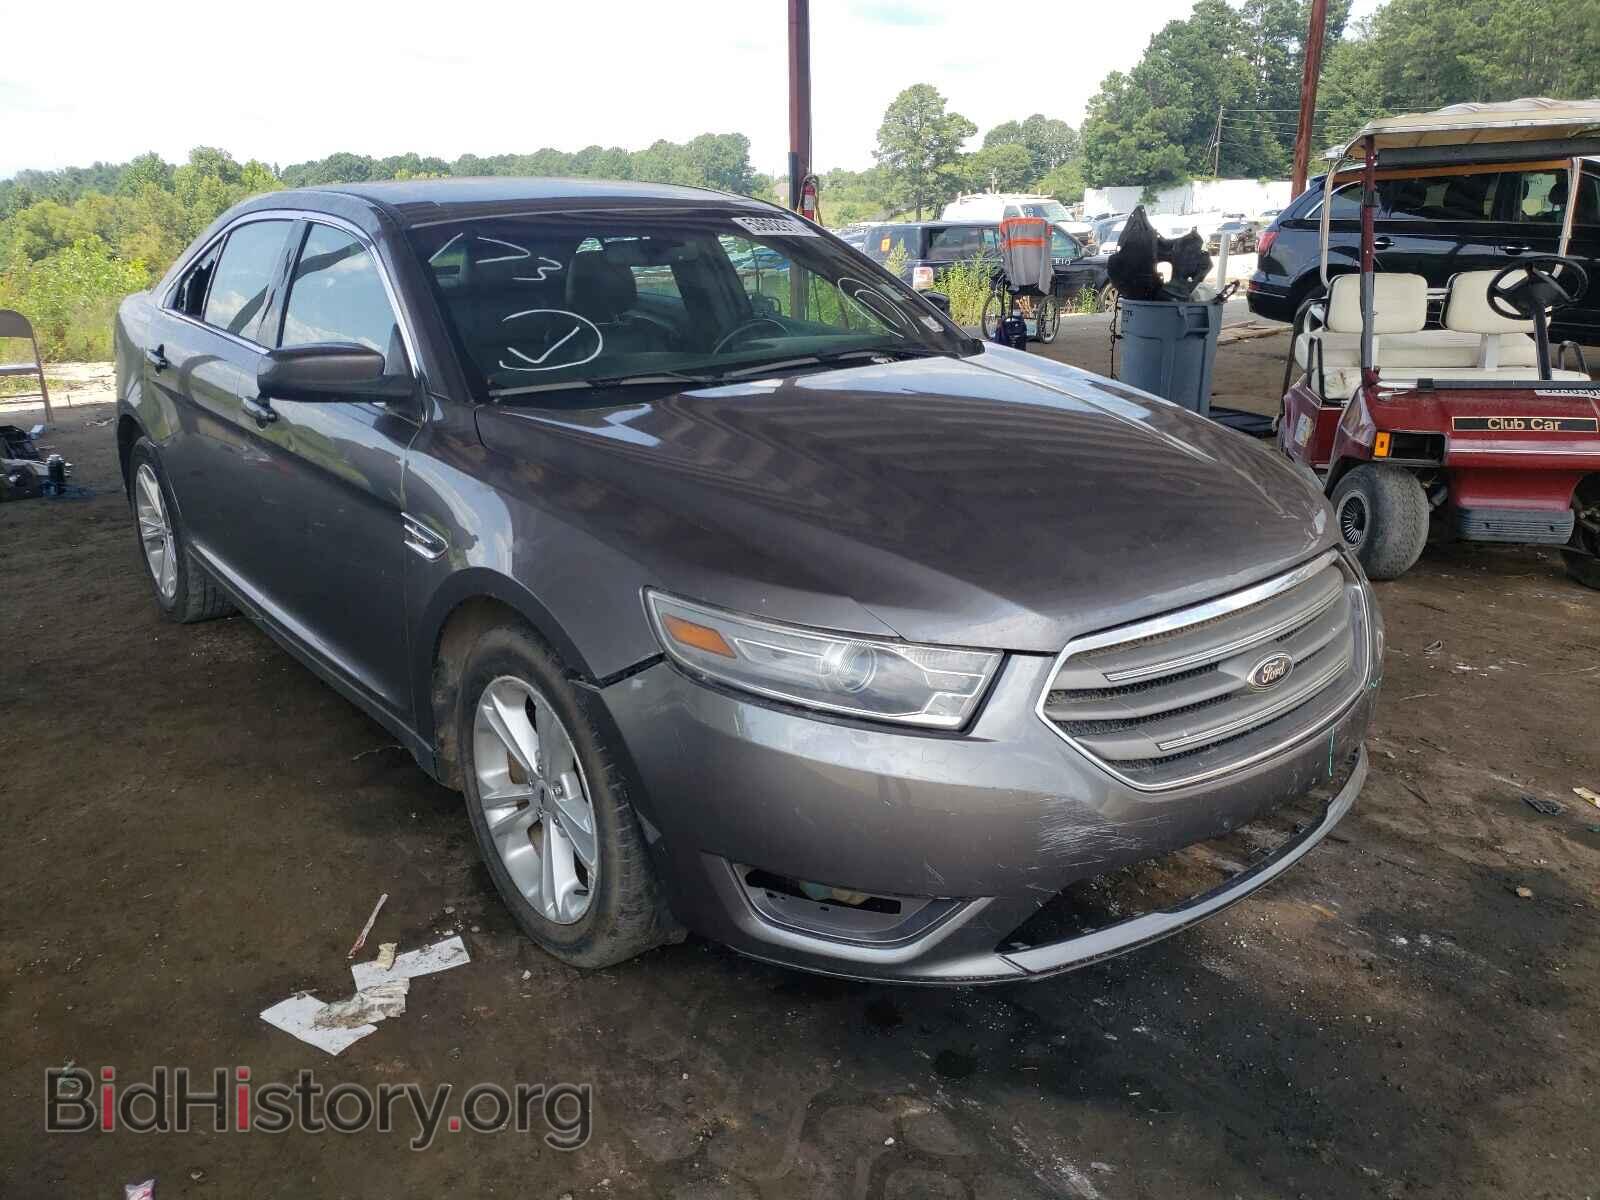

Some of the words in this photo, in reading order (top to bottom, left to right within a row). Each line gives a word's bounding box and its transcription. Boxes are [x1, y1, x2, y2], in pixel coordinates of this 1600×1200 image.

[1487, 418, 1525, 430] Club
[1530, 418, 1561, 431] Car
[1262, 660, 1286, 683] Ford
